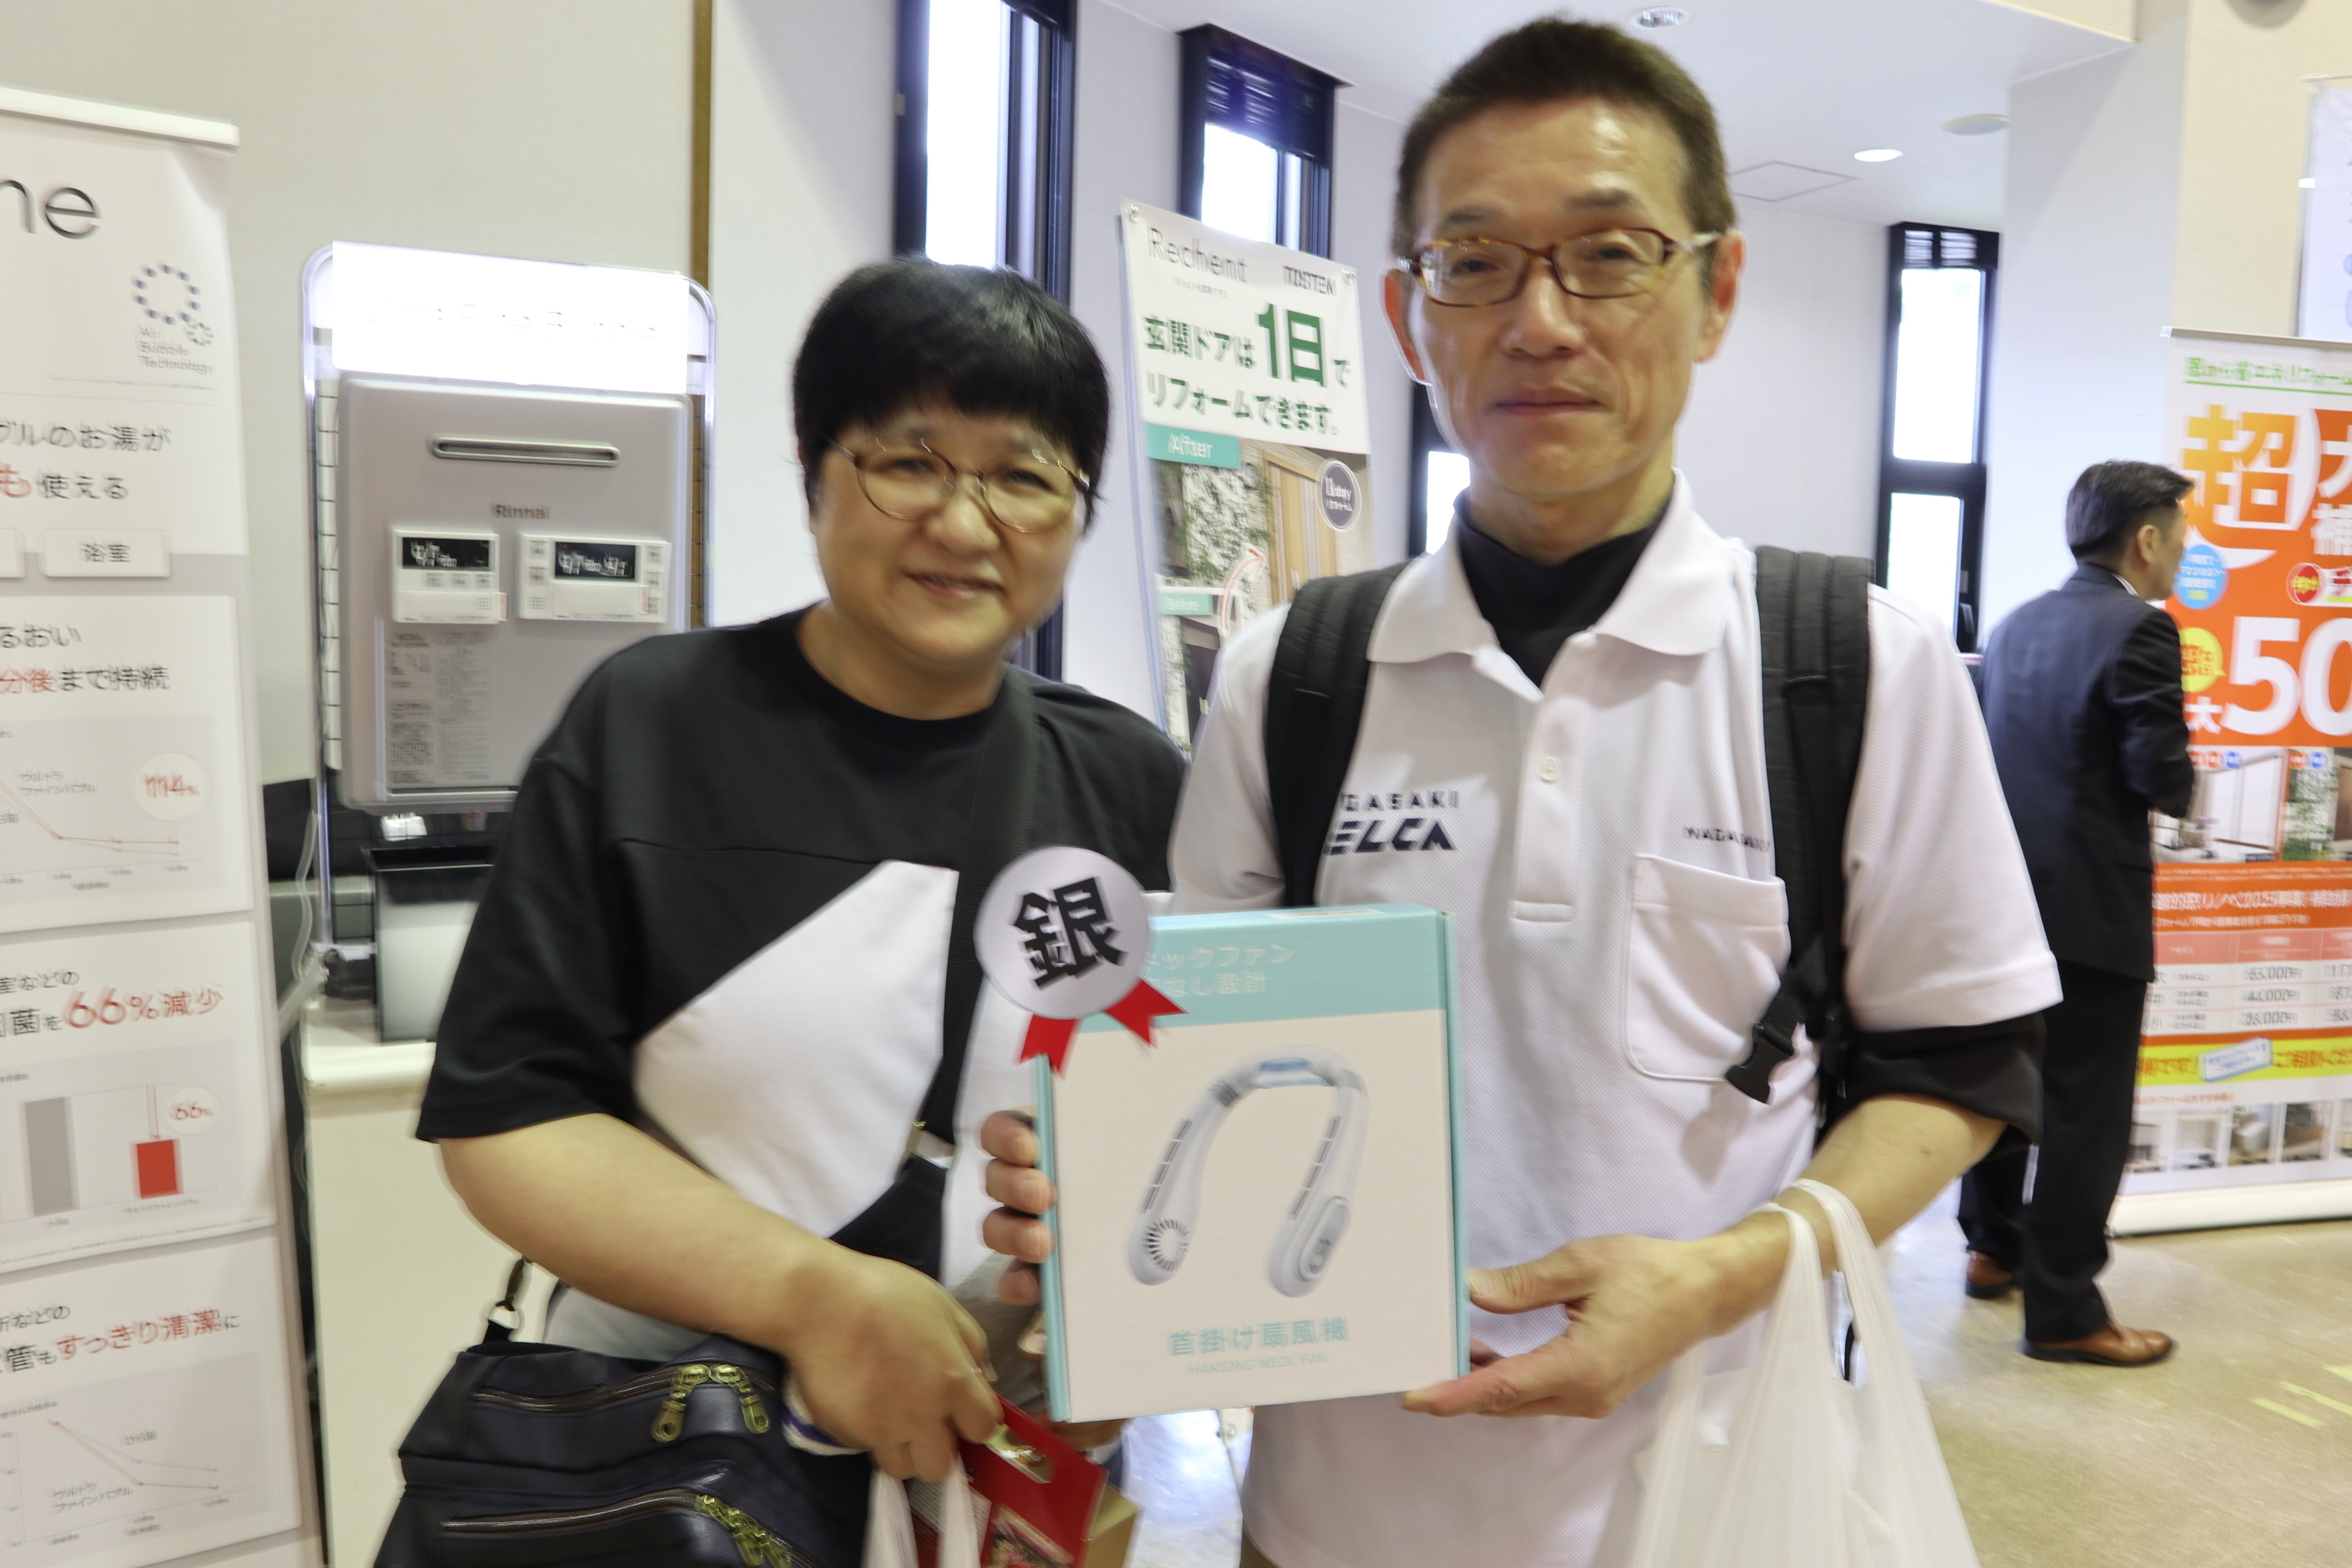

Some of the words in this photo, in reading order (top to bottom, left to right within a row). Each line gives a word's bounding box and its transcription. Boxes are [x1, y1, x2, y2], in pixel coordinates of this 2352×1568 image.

[1142, 303, 1352, 389] 玄関ドアは1日で
[1146, 372, 1339, 437] リフォームできます。
[1167, 433, 1213, 459] After
[493, 504, 550, 520] Rinnai
[80, 542, 132, 563] 浴室
[0, 665, 171, 694] 分後まで持続
[1007, 875, 1127, 990] 銀
[0, 986, 224, 1038] 菌を66%減少
[0, 1308, 241, 1373] 管もすっきり清潔に
[1168, 1317, 1350, 1357] 首掛け扇風機
